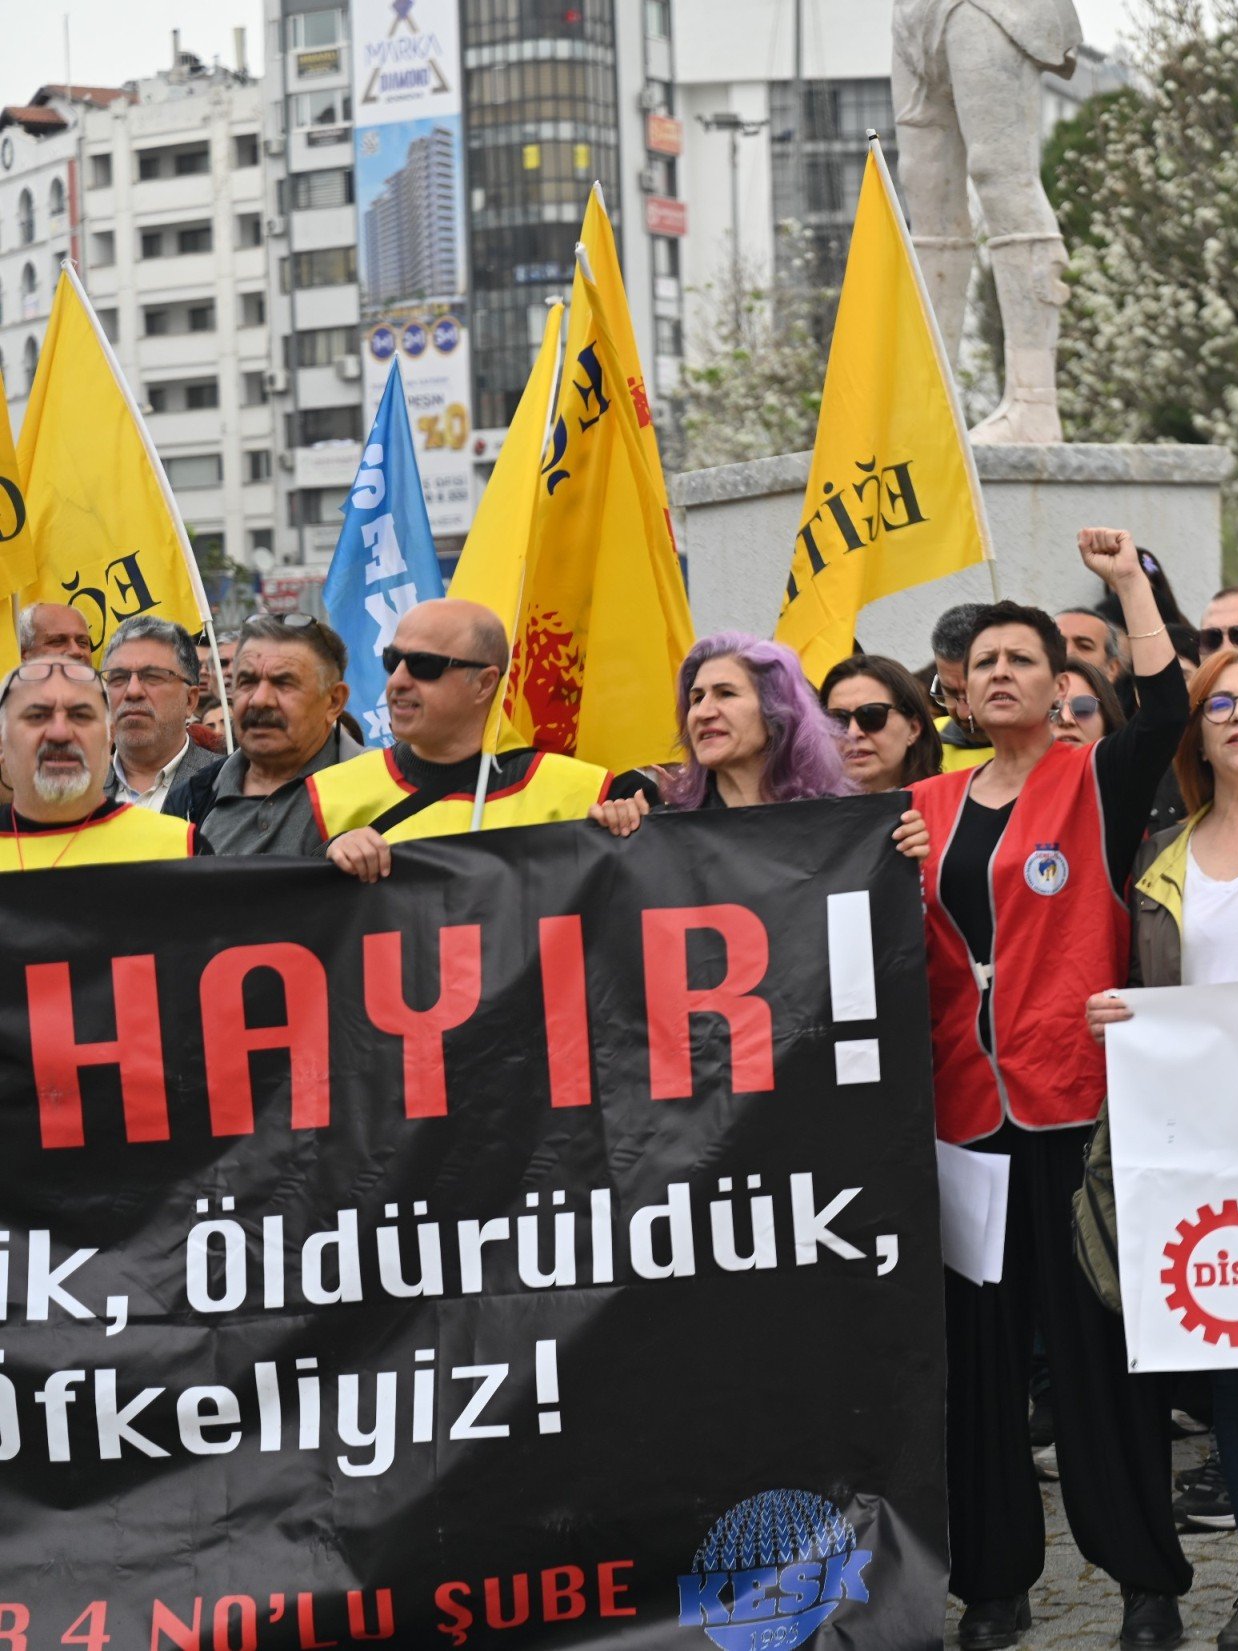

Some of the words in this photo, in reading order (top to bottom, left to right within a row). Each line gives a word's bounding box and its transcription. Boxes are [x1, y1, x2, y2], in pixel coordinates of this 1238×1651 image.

[186, 1172, 899, 1313] Öldürüldük,
[60, 1600, 110, 1651] 4
[434, 1559, 638, 1646] ŞUBE
[677, 1550, 873, 1627] KESK
